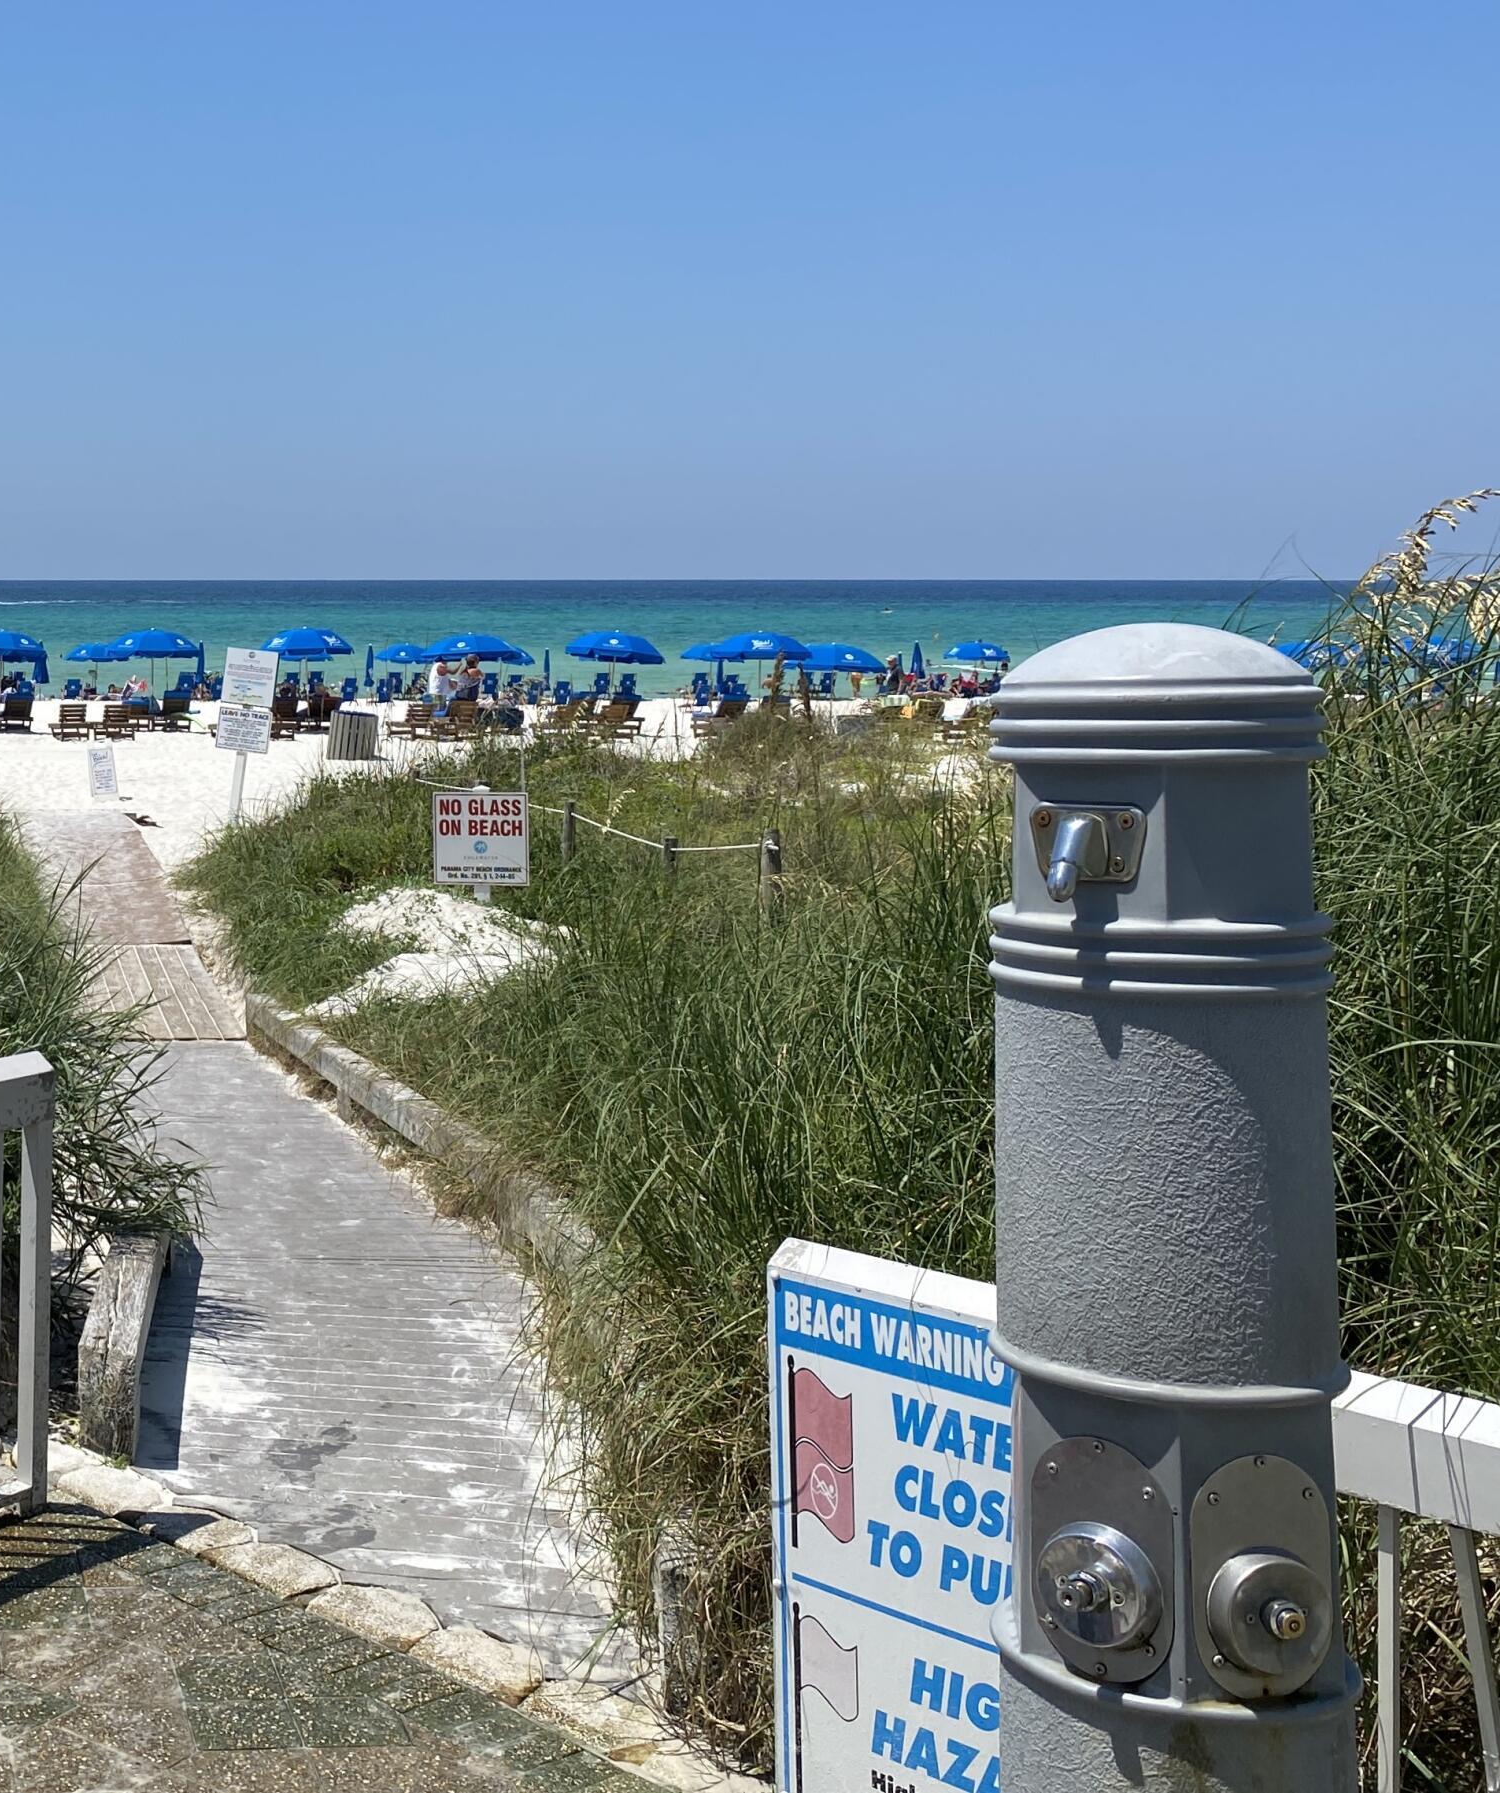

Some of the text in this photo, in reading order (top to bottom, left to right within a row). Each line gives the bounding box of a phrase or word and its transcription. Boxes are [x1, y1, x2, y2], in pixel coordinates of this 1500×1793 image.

[439, 799, 522, 816] NO GLASS
[439, 819, 523, 837] ON BEACH
[784, 1291, 1005, 1386] BEACH WARNING
[894, 1464, 1012, 1542] CLOS
[867, 1519, 1012, 1605] TO PU
[910, 1657, 1000, 1732] HIG
